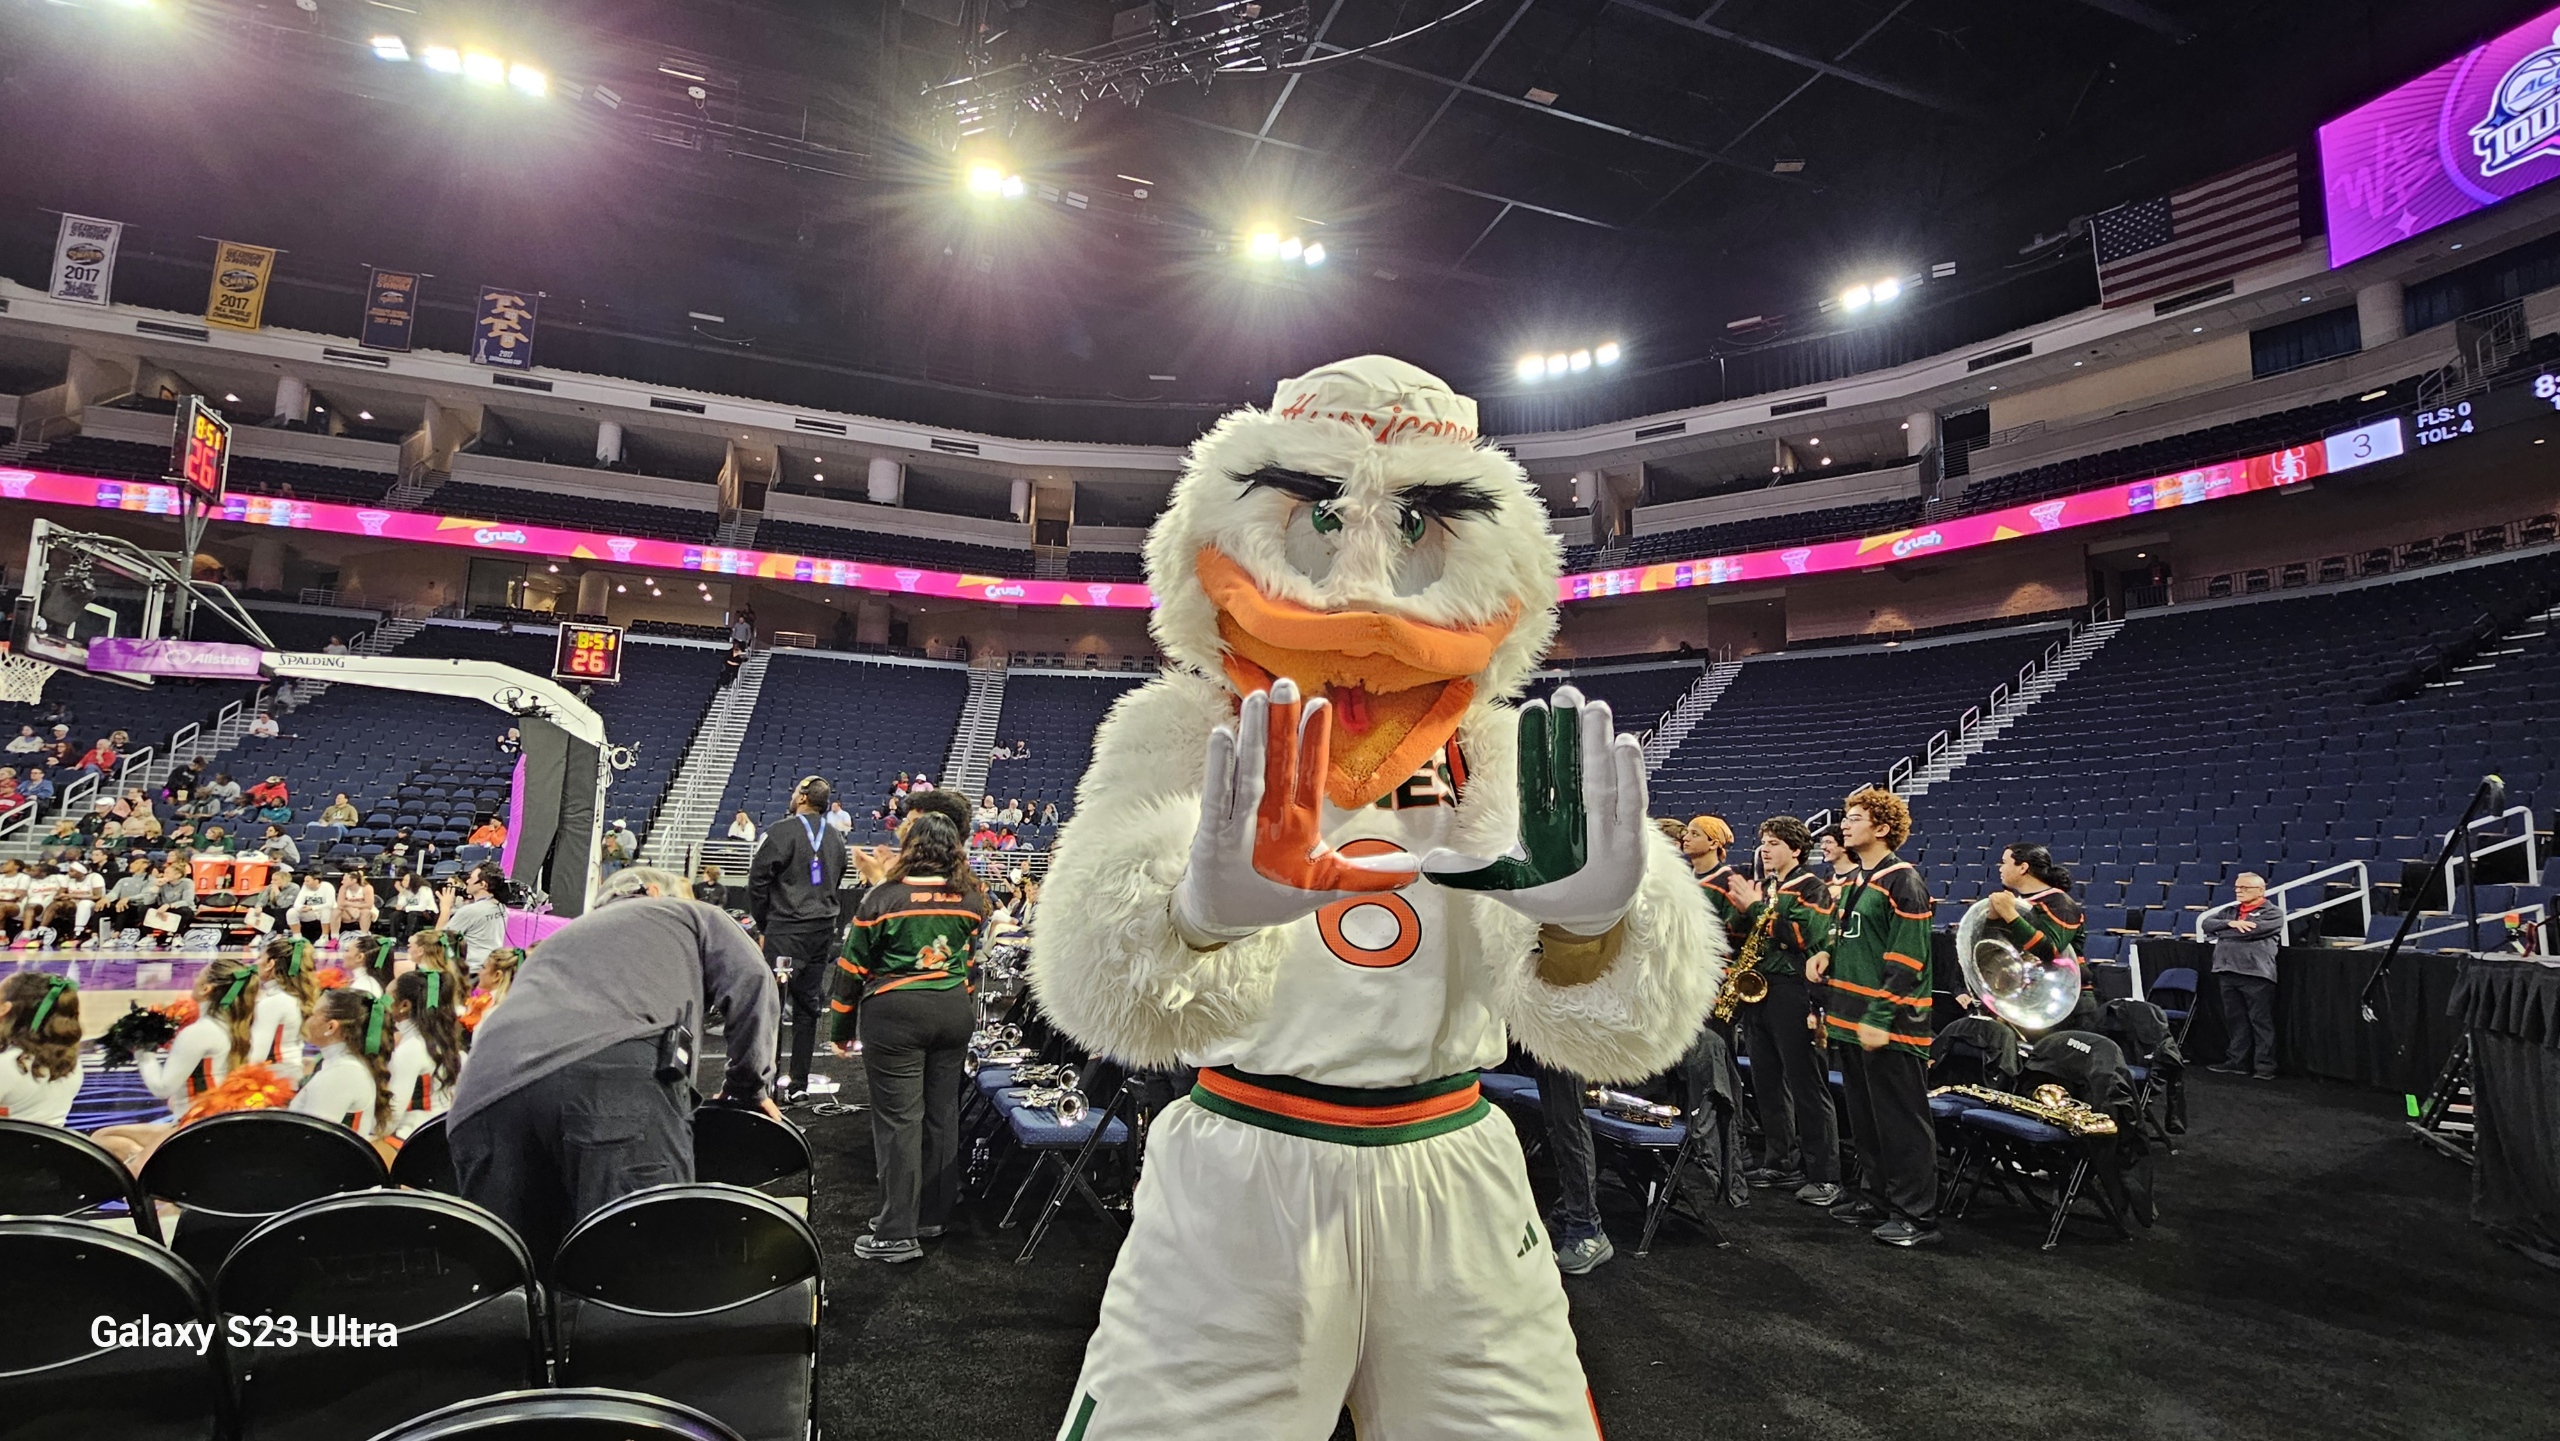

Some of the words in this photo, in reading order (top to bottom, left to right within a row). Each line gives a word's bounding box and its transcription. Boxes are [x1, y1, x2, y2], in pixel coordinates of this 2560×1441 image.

[64, 265, 100, 282] 2017
[220, 294, 249, 310] 2017
[2417, 407, 2455, 428] FLS:
[2457, 401, 2472, 416] 0
[196, 415, 221, 450] 8:51
[2416, 425, 2458, 446] TOL:
[2460, 419, 2474, 434] 4
[2352, 433, 2372, 458] 3
[188, 437, 214, 489] 26
[474, 529, 526, 544] Crush
[1892, 530, 1943, 557] Crush
[985, 584, 1025, 598] Crush
[577, 631, 616, 650] 8:51
[191, 653, 250, 666] Allstate
[279, 654, 345, 668] SPALDING
[571, 650, 606, 673] 26
